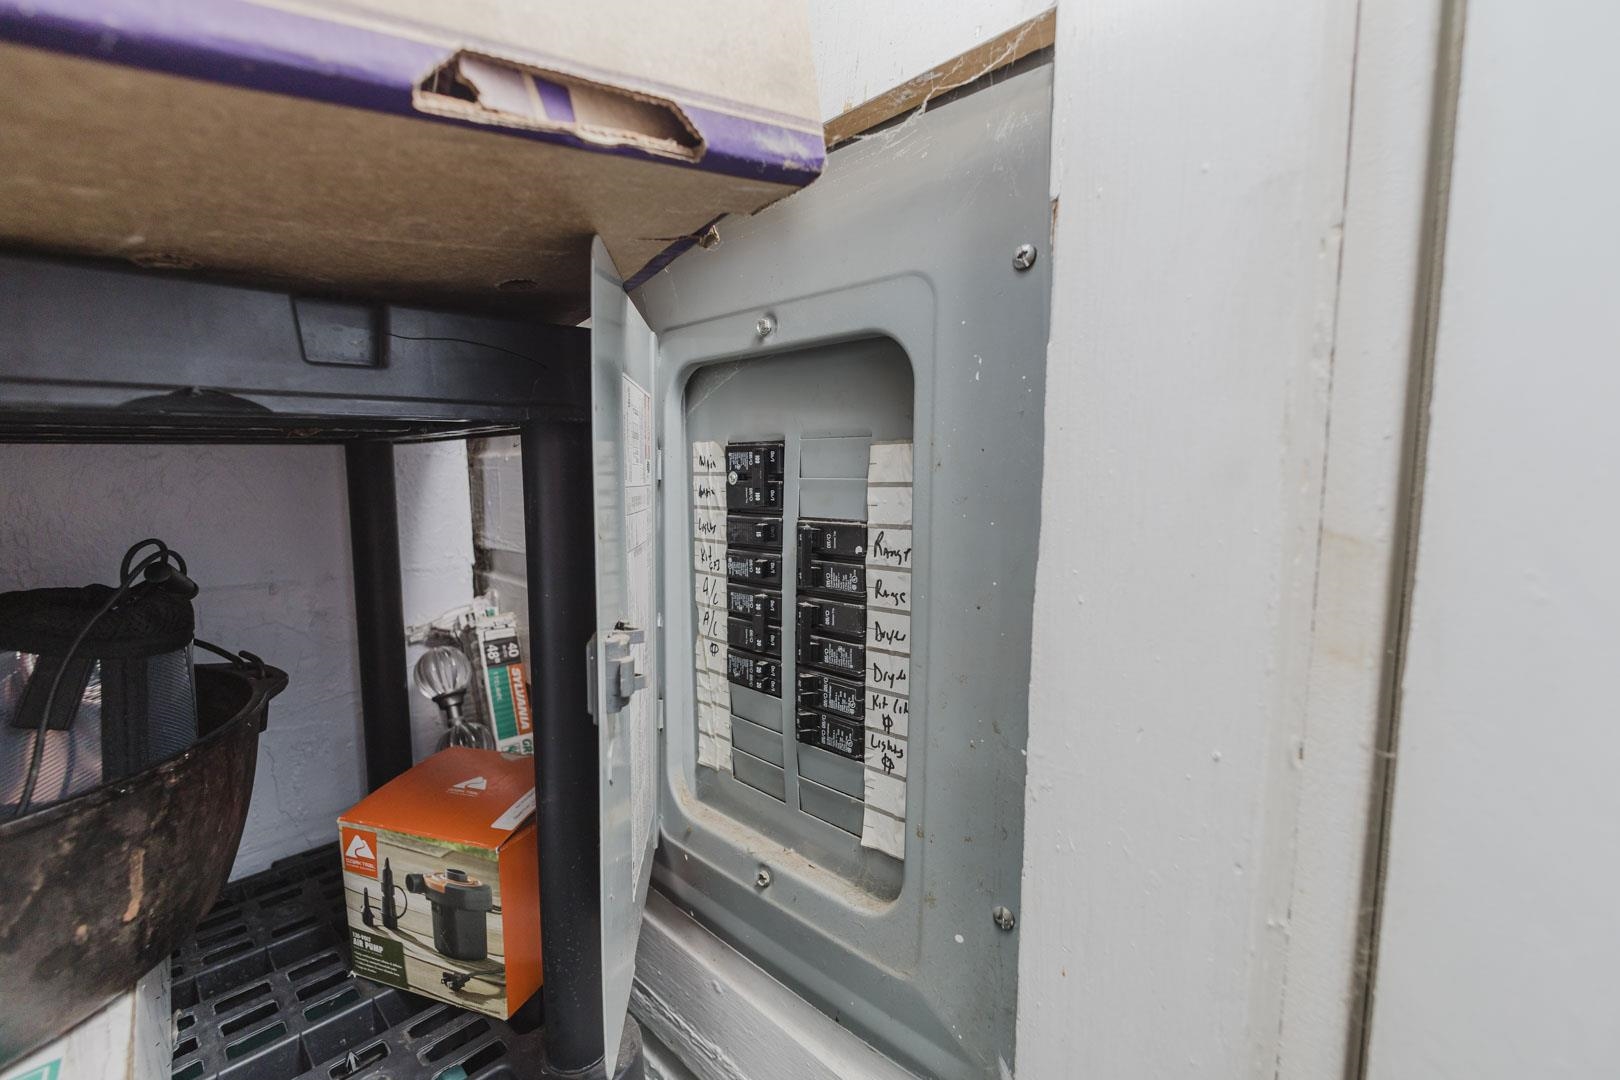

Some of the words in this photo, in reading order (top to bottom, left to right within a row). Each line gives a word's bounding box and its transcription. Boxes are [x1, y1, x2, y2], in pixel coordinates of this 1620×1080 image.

[702, 577, 719, 606] A/C
[703, 610, 718, 637] A/C
[507, 642, 519, 658] 40
[511, 666, 530, 730] SYLVANIA
[872, 694, 888, 711] Kit
[364, 941, 384, 954] PUMP
